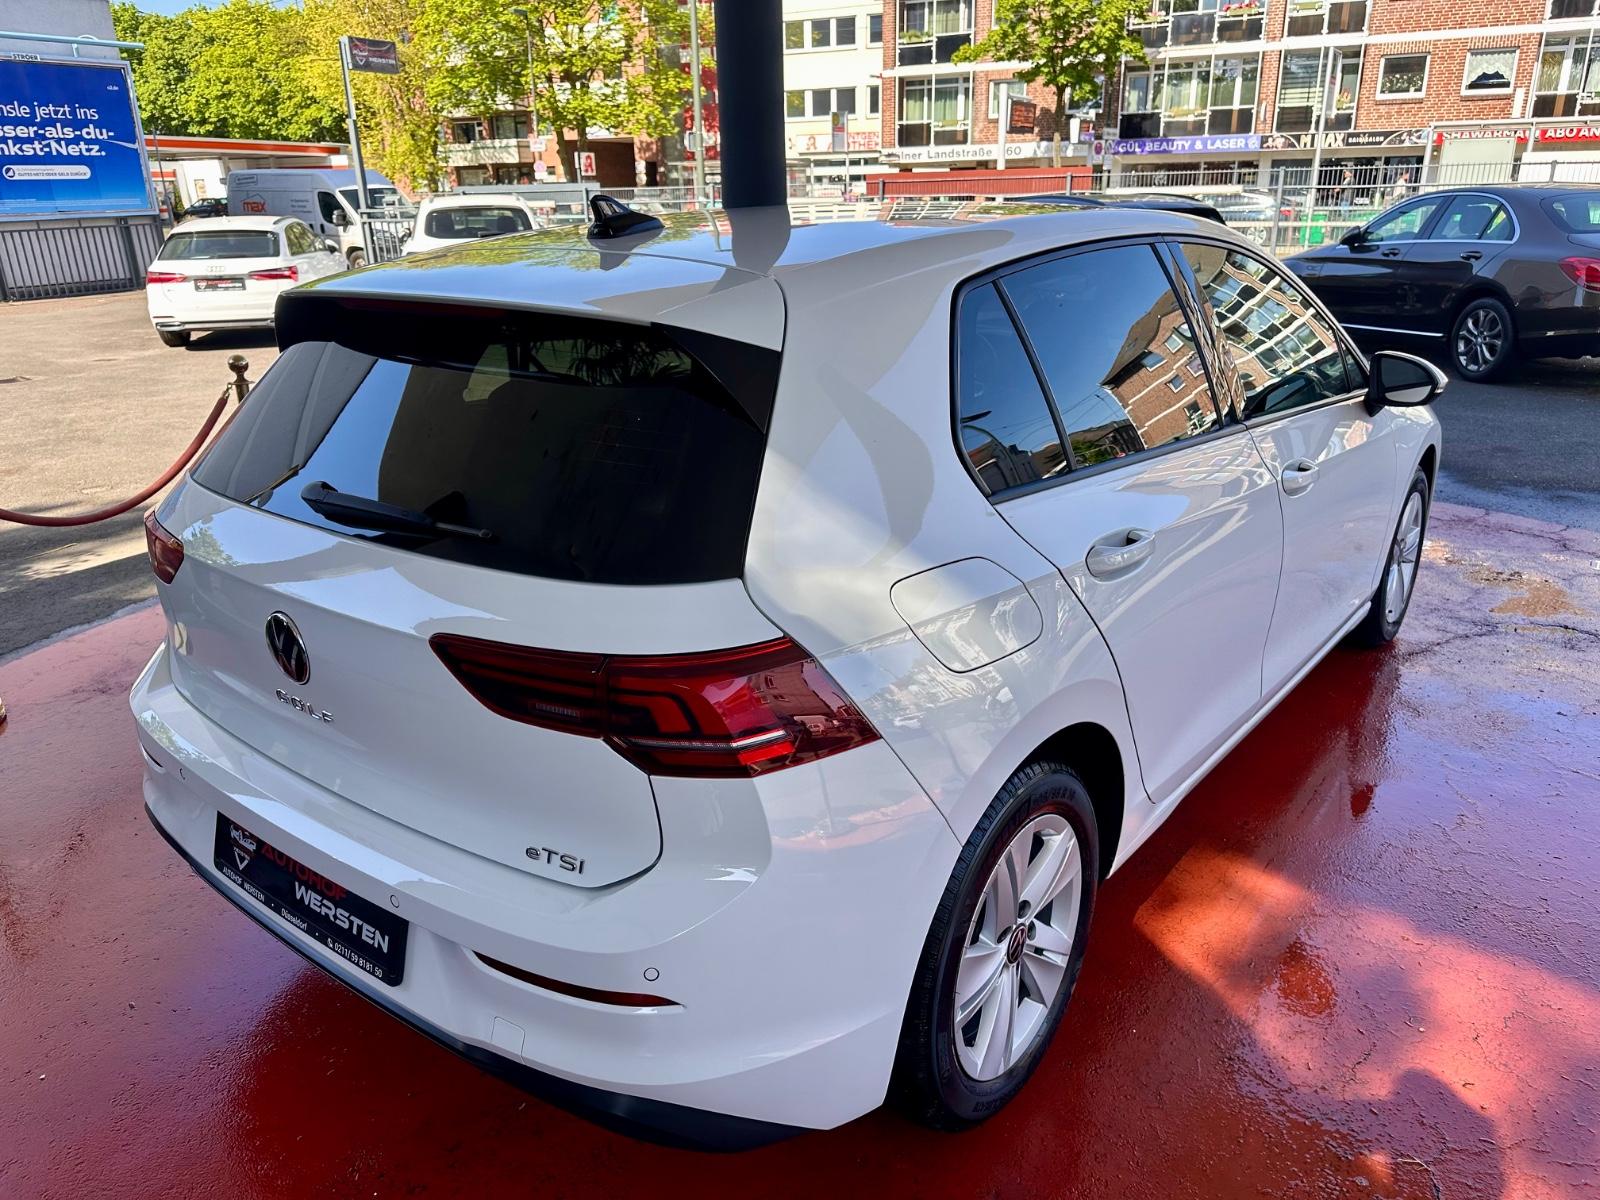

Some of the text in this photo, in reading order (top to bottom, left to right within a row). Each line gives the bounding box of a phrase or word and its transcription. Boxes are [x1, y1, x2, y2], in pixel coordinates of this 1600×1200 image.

[33, 101, 73, 122] jetzt
[75, 103, 99, 120] ins
[0, 122, 115, 140] ser-als-du-
[927, 147, 993, 160] Landstraße
[1006, 145, 1022, 156] 60
[1145, 139, 1191, 151] BEAUTY
[1194, 139, 1204, 150] &
[1207, 137, 1245, 149] LASER
[276, 688, 334, 723] GOLF
[525, 846, 585, 874] eTSI
[243, 881, 265, 902] WERSTEN
[281, 907, 308, 931] Düsseldorf
[295, 881, 389, 954] WERSTEN
